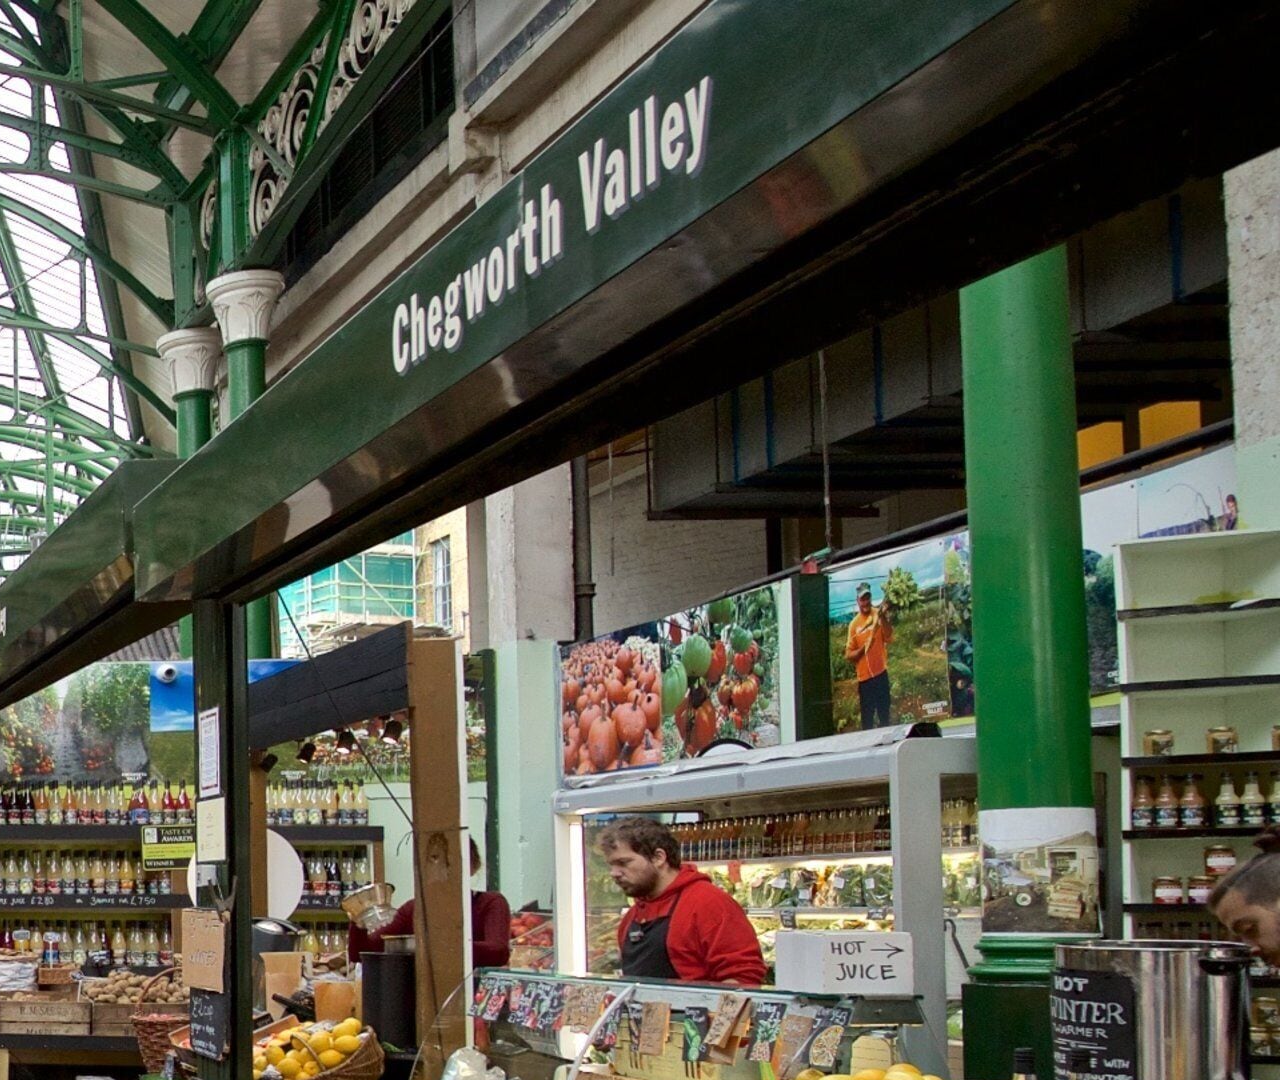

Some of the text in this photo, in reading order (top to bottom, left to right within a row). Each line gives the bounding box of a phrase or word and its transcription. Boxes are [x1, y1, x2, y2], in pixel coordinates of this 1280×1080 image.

[393, 76, 713, 375] Chegworth Valley
[161, 834, 194, 843] AWARDS
[830, 940, 867, 956] HOT
[835, 963, 898, 982] JUICE
[1054, 976, 1089, 992] HOT
[1103, 1058, 1130, 1069] WITH
